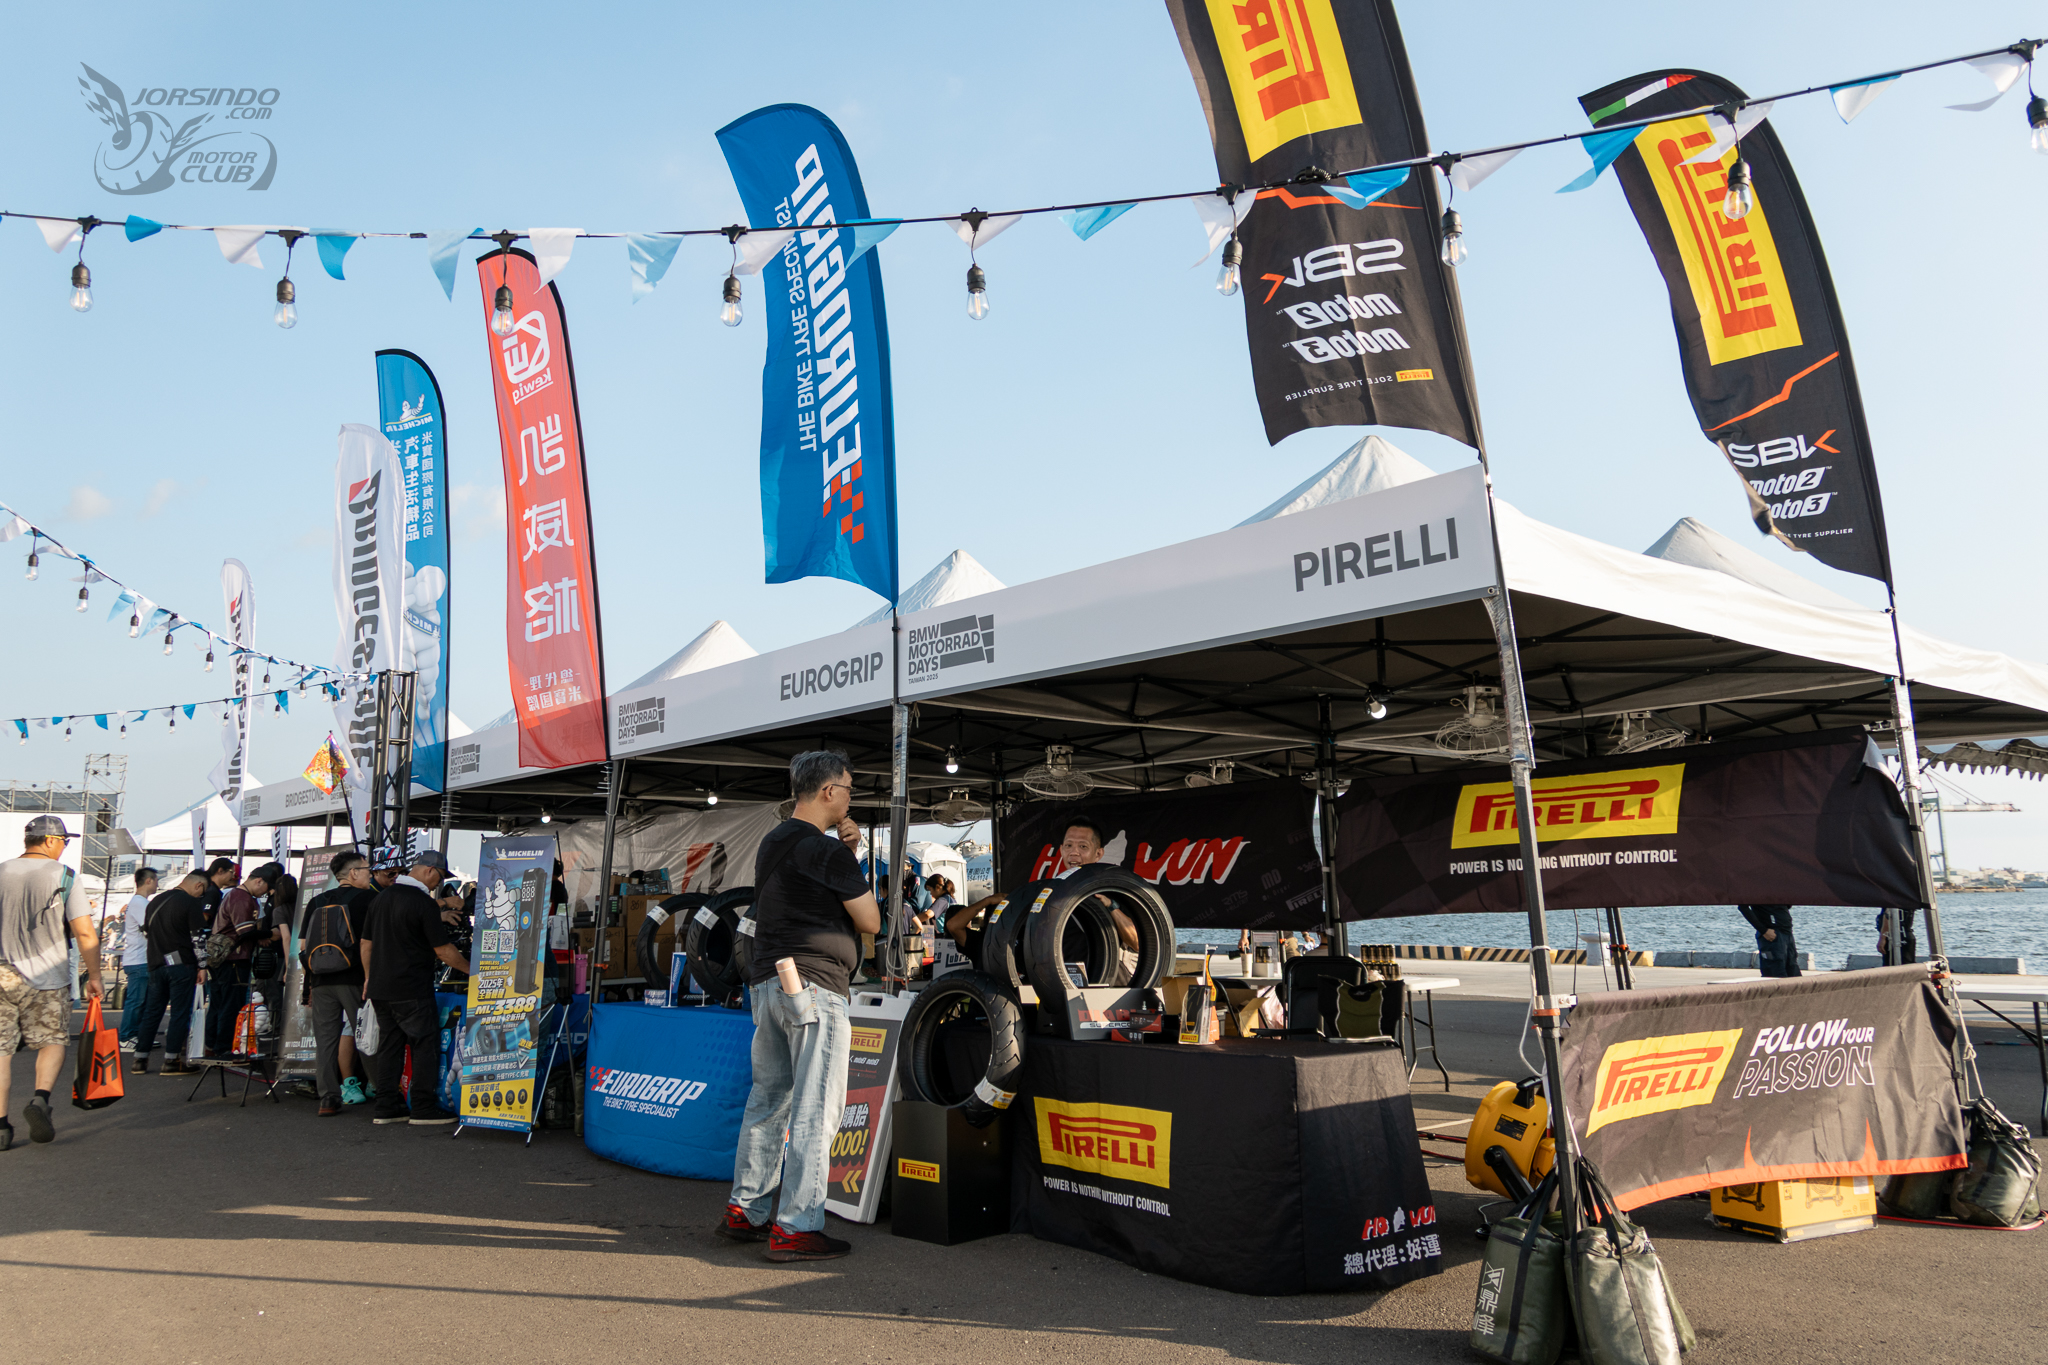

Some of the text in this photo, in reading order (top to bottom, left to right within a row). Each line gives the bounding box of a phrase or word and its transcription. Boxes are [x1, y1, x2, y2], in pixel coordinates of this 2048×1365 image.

[1728, 429, 1841, 468] SBK
[1814, 528, 1853, 538] SUPPLIER
[1294, 517, 1459, 592] PIRELLI
[909, 624, 940, 645] BMW
[908, 630, 981, 661] MOTORRAD
[780, 651, 884, 701] EUROGRIP
[908, 655, 939, 677] DAYS
[908, 673, 939, 685] TAIWAN 2025
[618, 702, 636, 716] BMW
[618, 708, 659, 728] MOTORRAD
[618, 725, 636, 740] DAYS
[450, 745, 463, 757] BMW
[450, 753, 476, 767] MOTORRAD
[450, 765, 462, 776] DAYS
[285, 787, 324, 808] BRIDGESTONE
[508, 850, 544, 858] MICHELIN
[1450, 849, 1677, 875] POWER IS NOING WITHOUT CONTROL
[475, 996, 537, 1016] ML-3388
[1597, 1018, 1875, 1113] PIRELLI FOLLOW YOUR
[1733, 1046, 1876, 1099] PASSION
[599, 1069, 708, 1107] EUROGRIP
[611, 1097, 623, 1110] BIKE
[622, 1100, 640, 1113] TYRE
[637, 1102, 680, 1119] SPECIALIST
[1048, 1111, 1156, 1170] PIRELLI
[902, 1162, 936, 1179] PIRELLI
[1043, 1176, 1070, 1192] POWER
[1071, 1181, 1079, 1194] IS
[1101, 1189, 1134, 1208] WITHOUT
[1135, 1196, 1171, 1217] CONTROL
